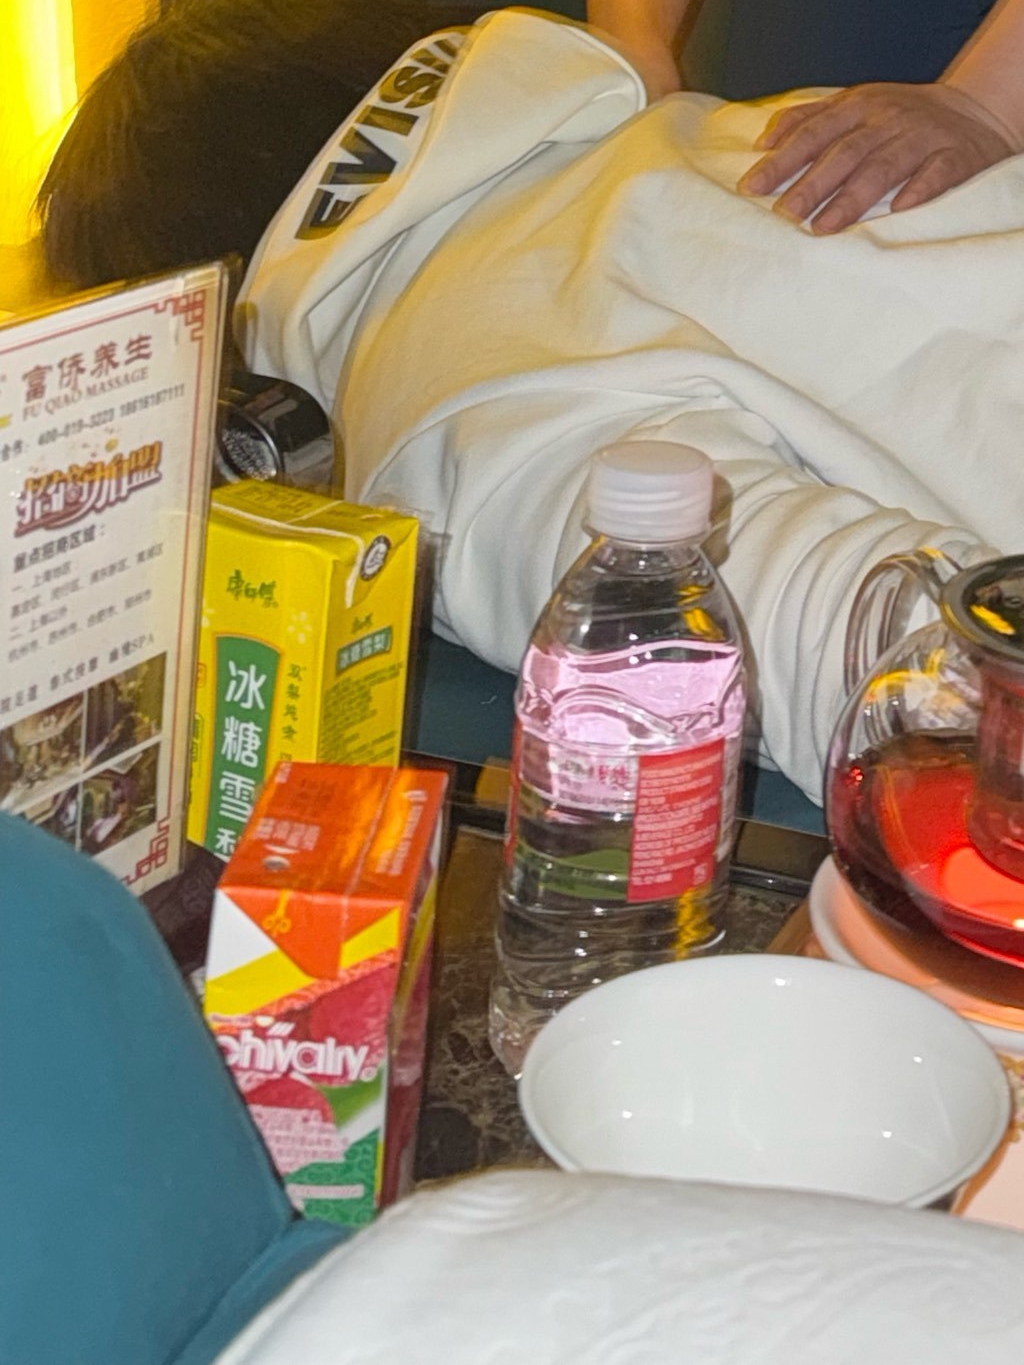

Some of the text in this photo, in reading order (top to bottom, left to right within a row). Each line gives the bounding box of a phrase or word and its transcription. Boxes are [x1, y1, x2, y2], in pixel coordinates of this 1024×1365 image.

[22, 334, 153, 403] 富侨养生
[22, 366, 149, 421] FU QIAO MASSAGE
